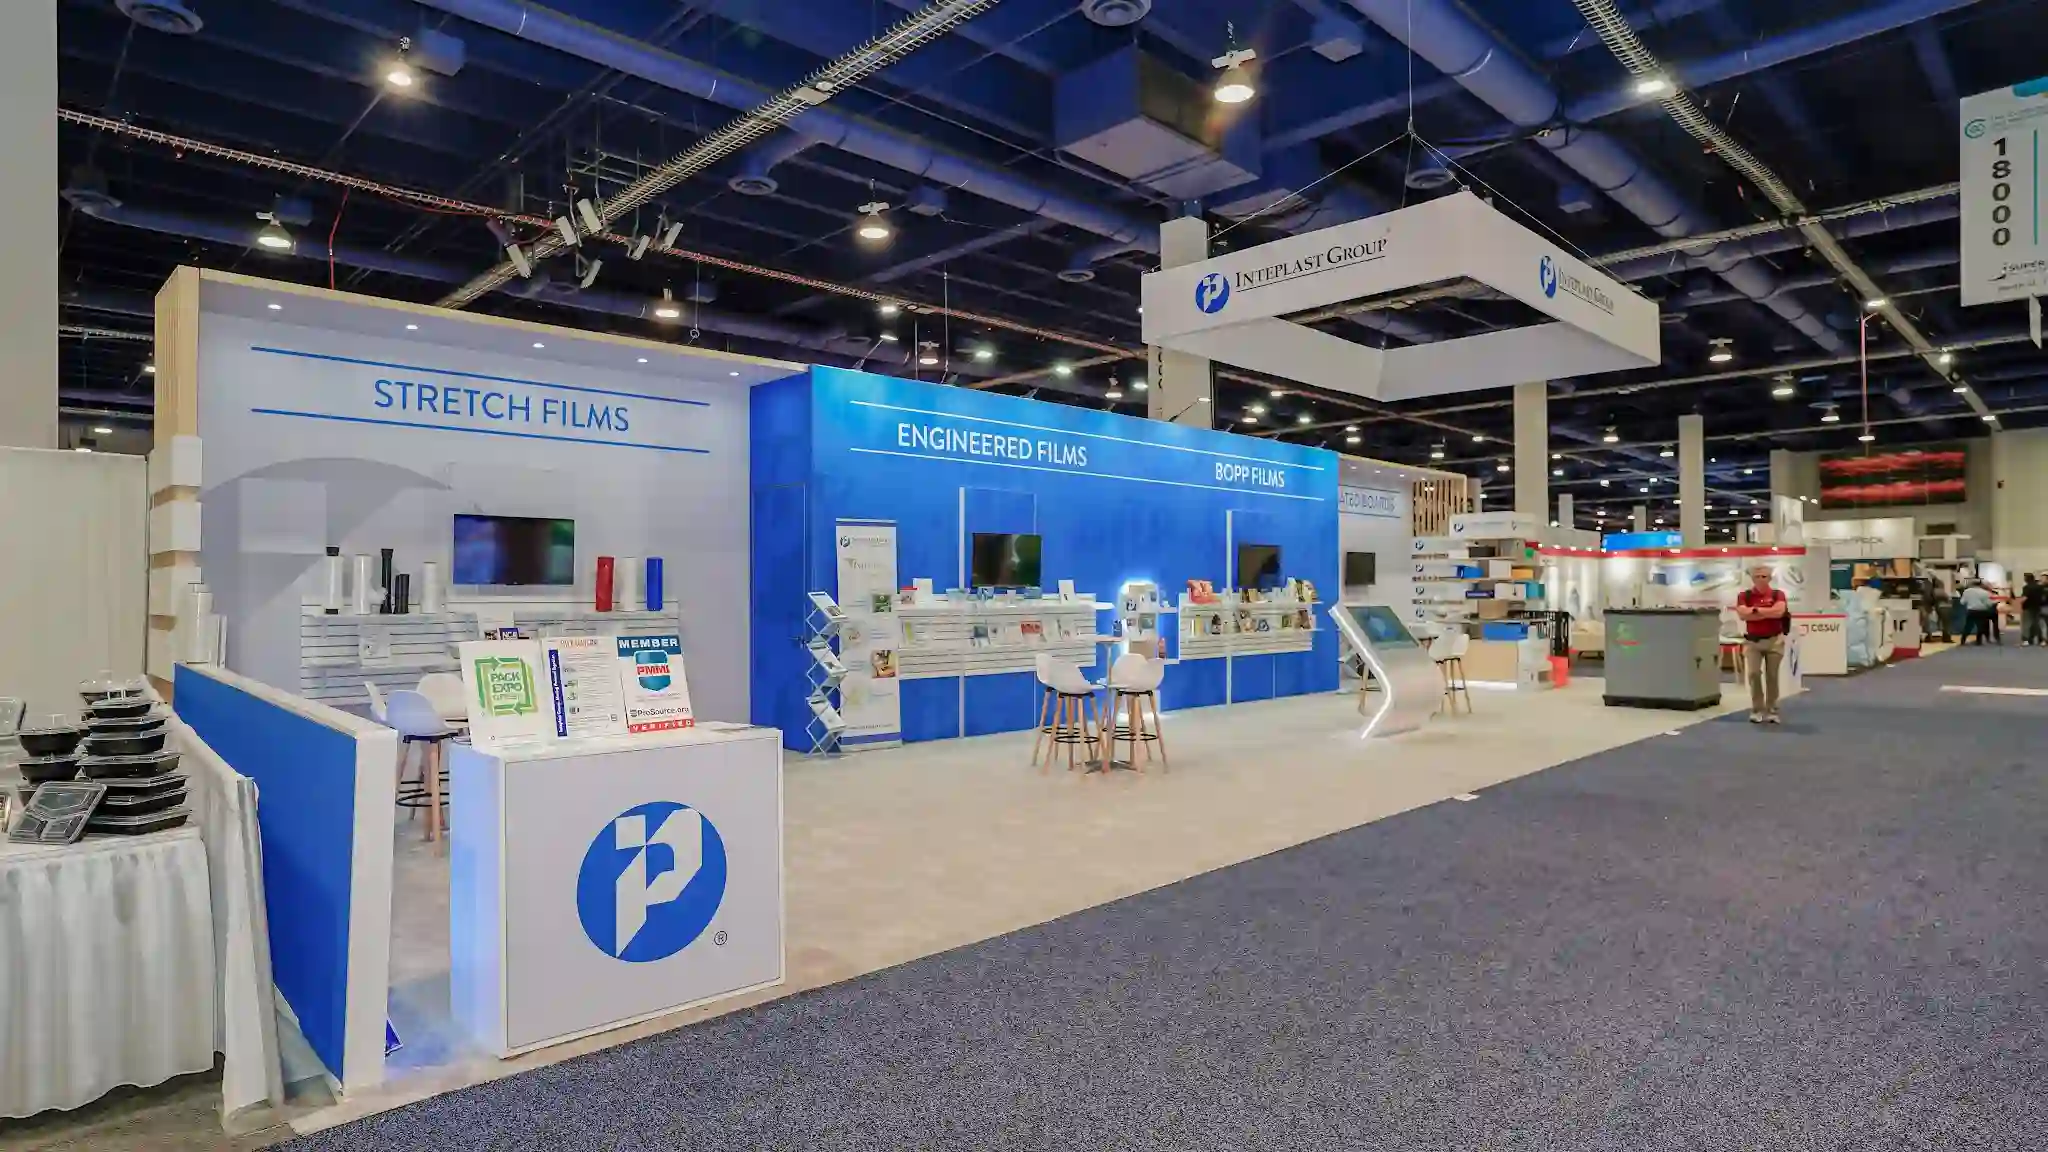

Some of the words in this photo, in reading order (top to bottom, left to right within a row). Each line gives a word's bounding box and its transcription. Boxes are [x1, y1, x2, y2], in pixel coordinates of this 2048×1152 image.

[1992, 137, 2012, 246] 18000
[1235, 253, 1324, 288] INTEPLAST
[1327, 238, 1388, 265] GROUP
[374, 379, 531, 422] STRETCH
[542, 398, 630, 432] FILMS
[897, 422, 1033, 461] ENGINEERED
[1037, 440, 1088, 467] FILMS
[1214, 462, 1250, 483] BOPP
[1251, 470, 1286, 488] FILMS
[618, 638, 679, 649] MEMBER
[490, 671, 520, 683] PACK
[636, 664, 671, 676] PMMI
[492, 682, 523, 694] EXPO
